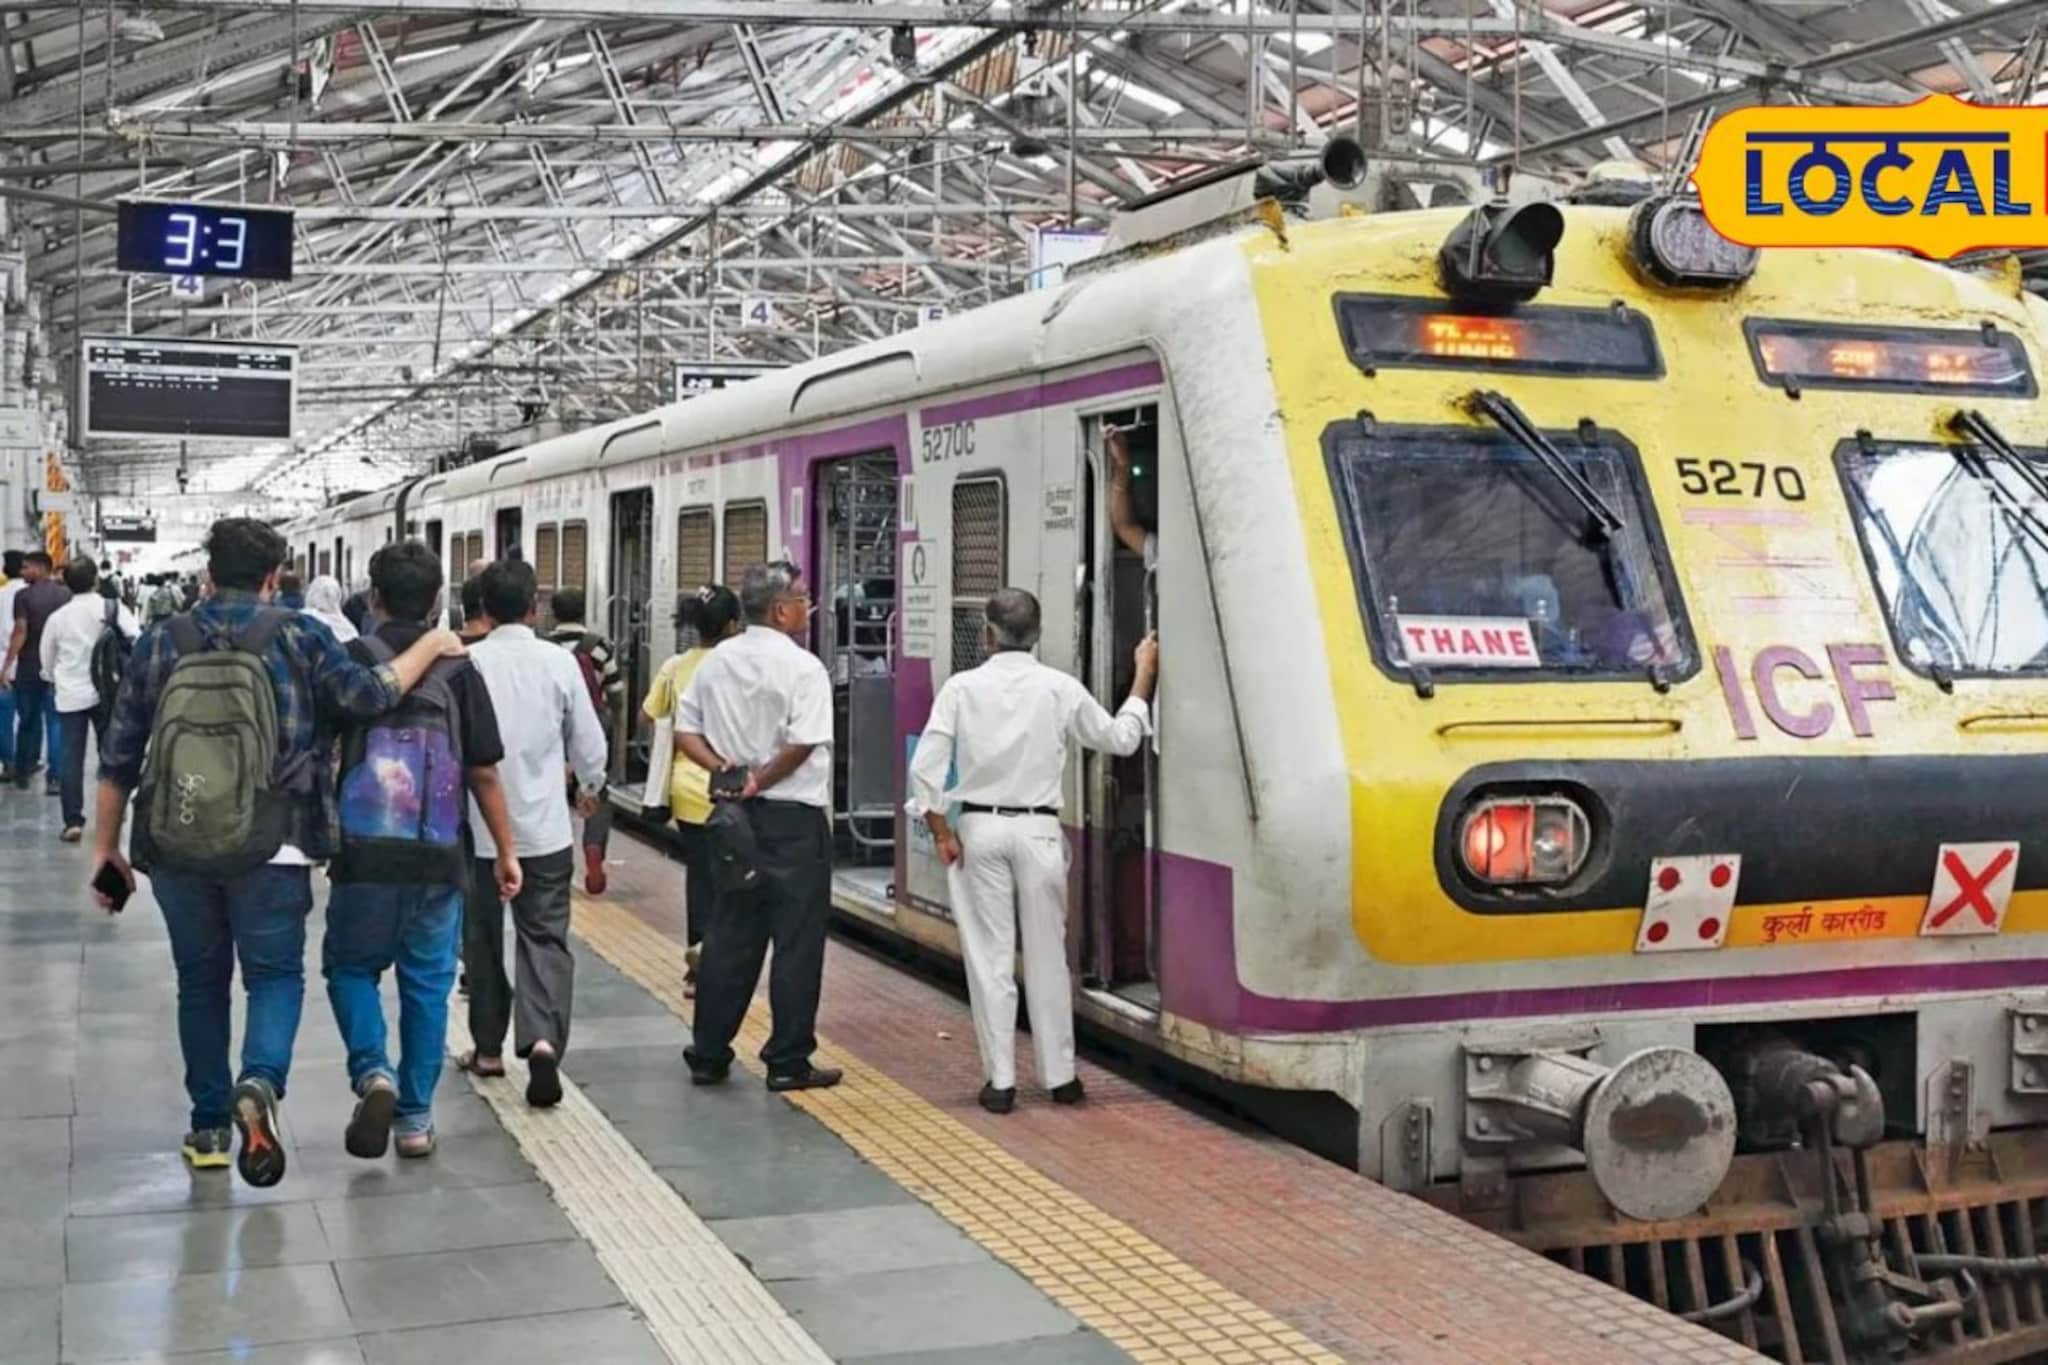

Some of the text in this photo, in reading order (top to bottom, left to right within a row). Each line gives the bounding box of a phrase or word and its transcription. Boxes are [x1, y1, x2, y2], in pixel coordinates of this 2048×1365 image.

[164, 213, 247, 269] 3:3
[751, 301, 769, 323] 4
[922, 421, 977, 464] 5270C
[1675, 457, 1806, 501] 5270
[1406, 627, 1531, 656] THANE
[1710, 643, 1896, 740] ICF
